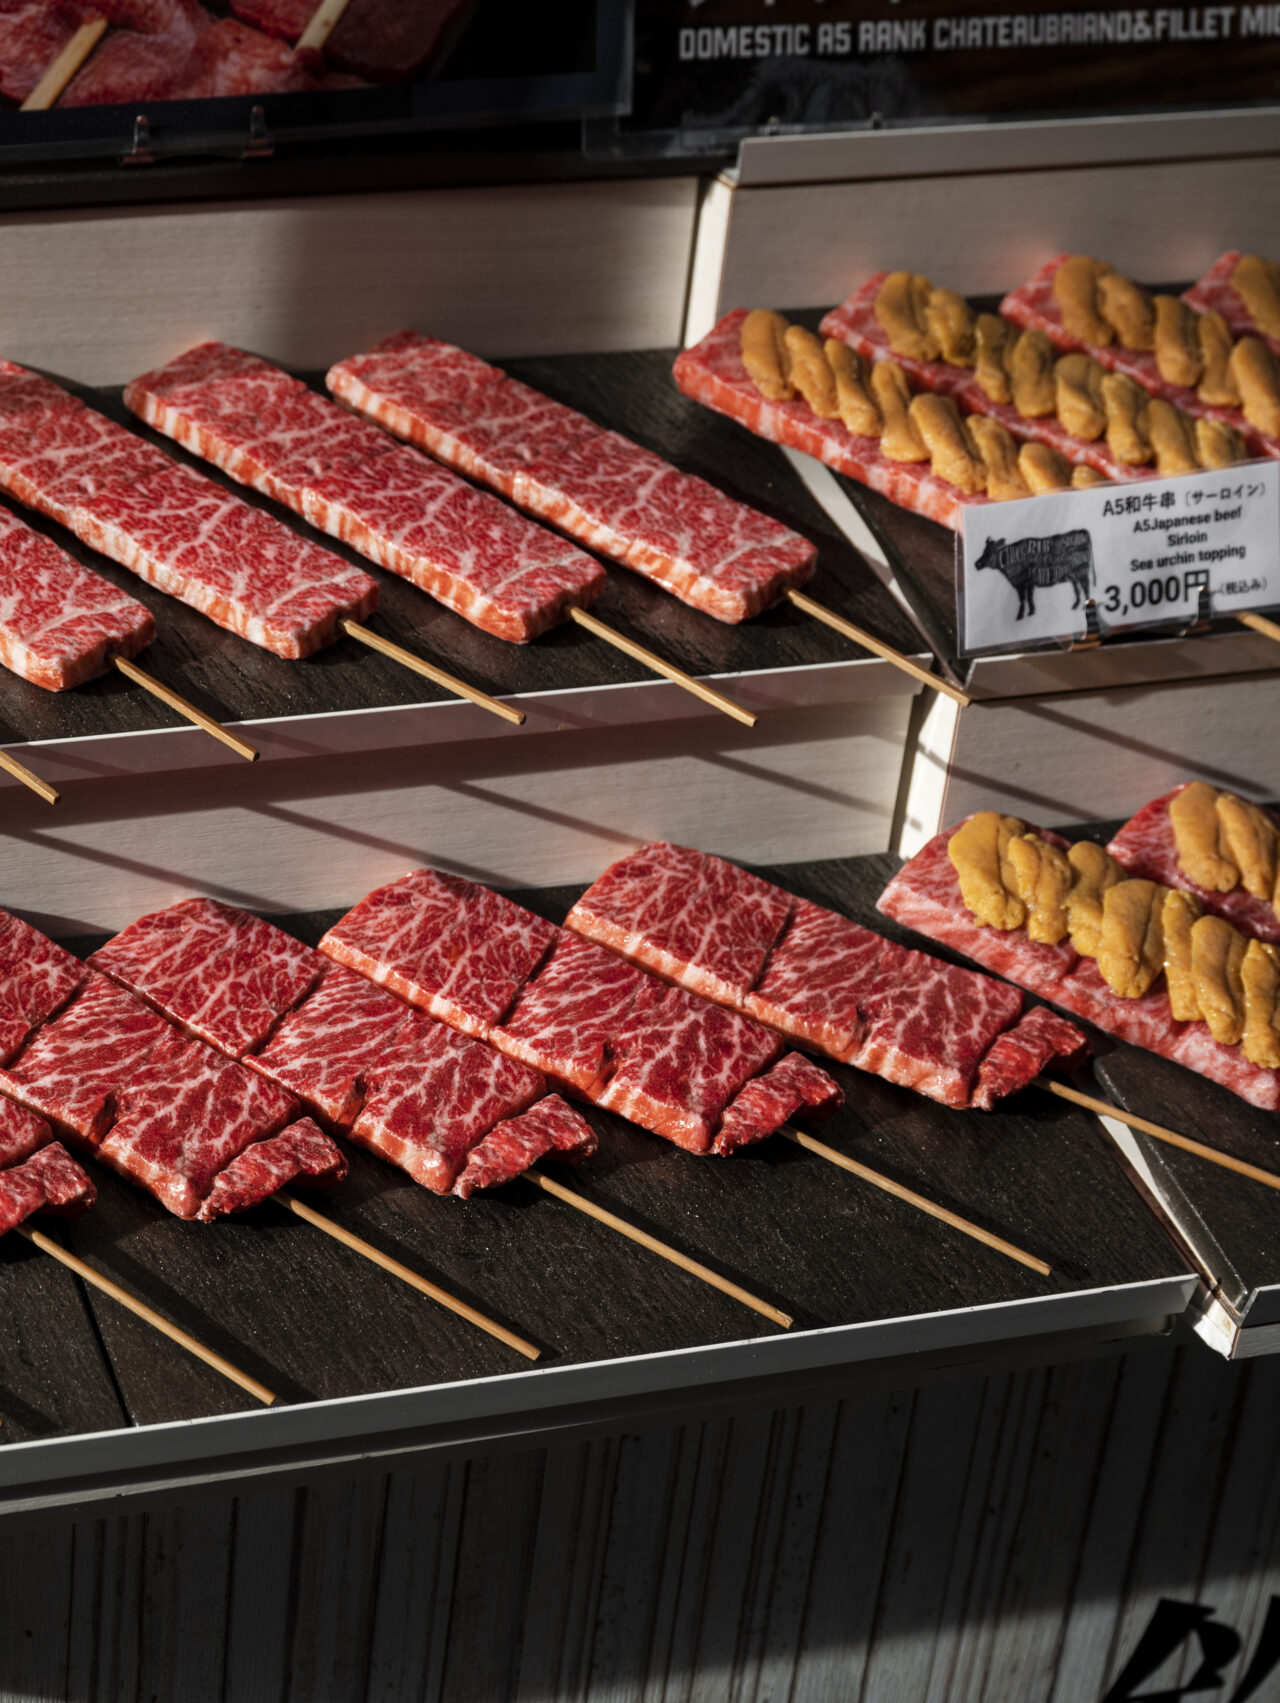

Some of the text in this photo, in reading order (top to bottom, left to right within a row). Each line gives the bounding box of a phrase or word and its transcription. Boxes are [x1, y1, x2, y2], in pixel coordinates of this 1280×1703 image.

[679, 24, 809, 60] DOMESTIC
[860, 19, 926, 53] RANK
[1133, 505, 1243, 533] A5Japanese beef
[1167, 531, 1208, 547] Sirloin
[1130, 545, 1246, 571] Sea urchin topping
[1104, 568, 1210, 616] 3,000円
